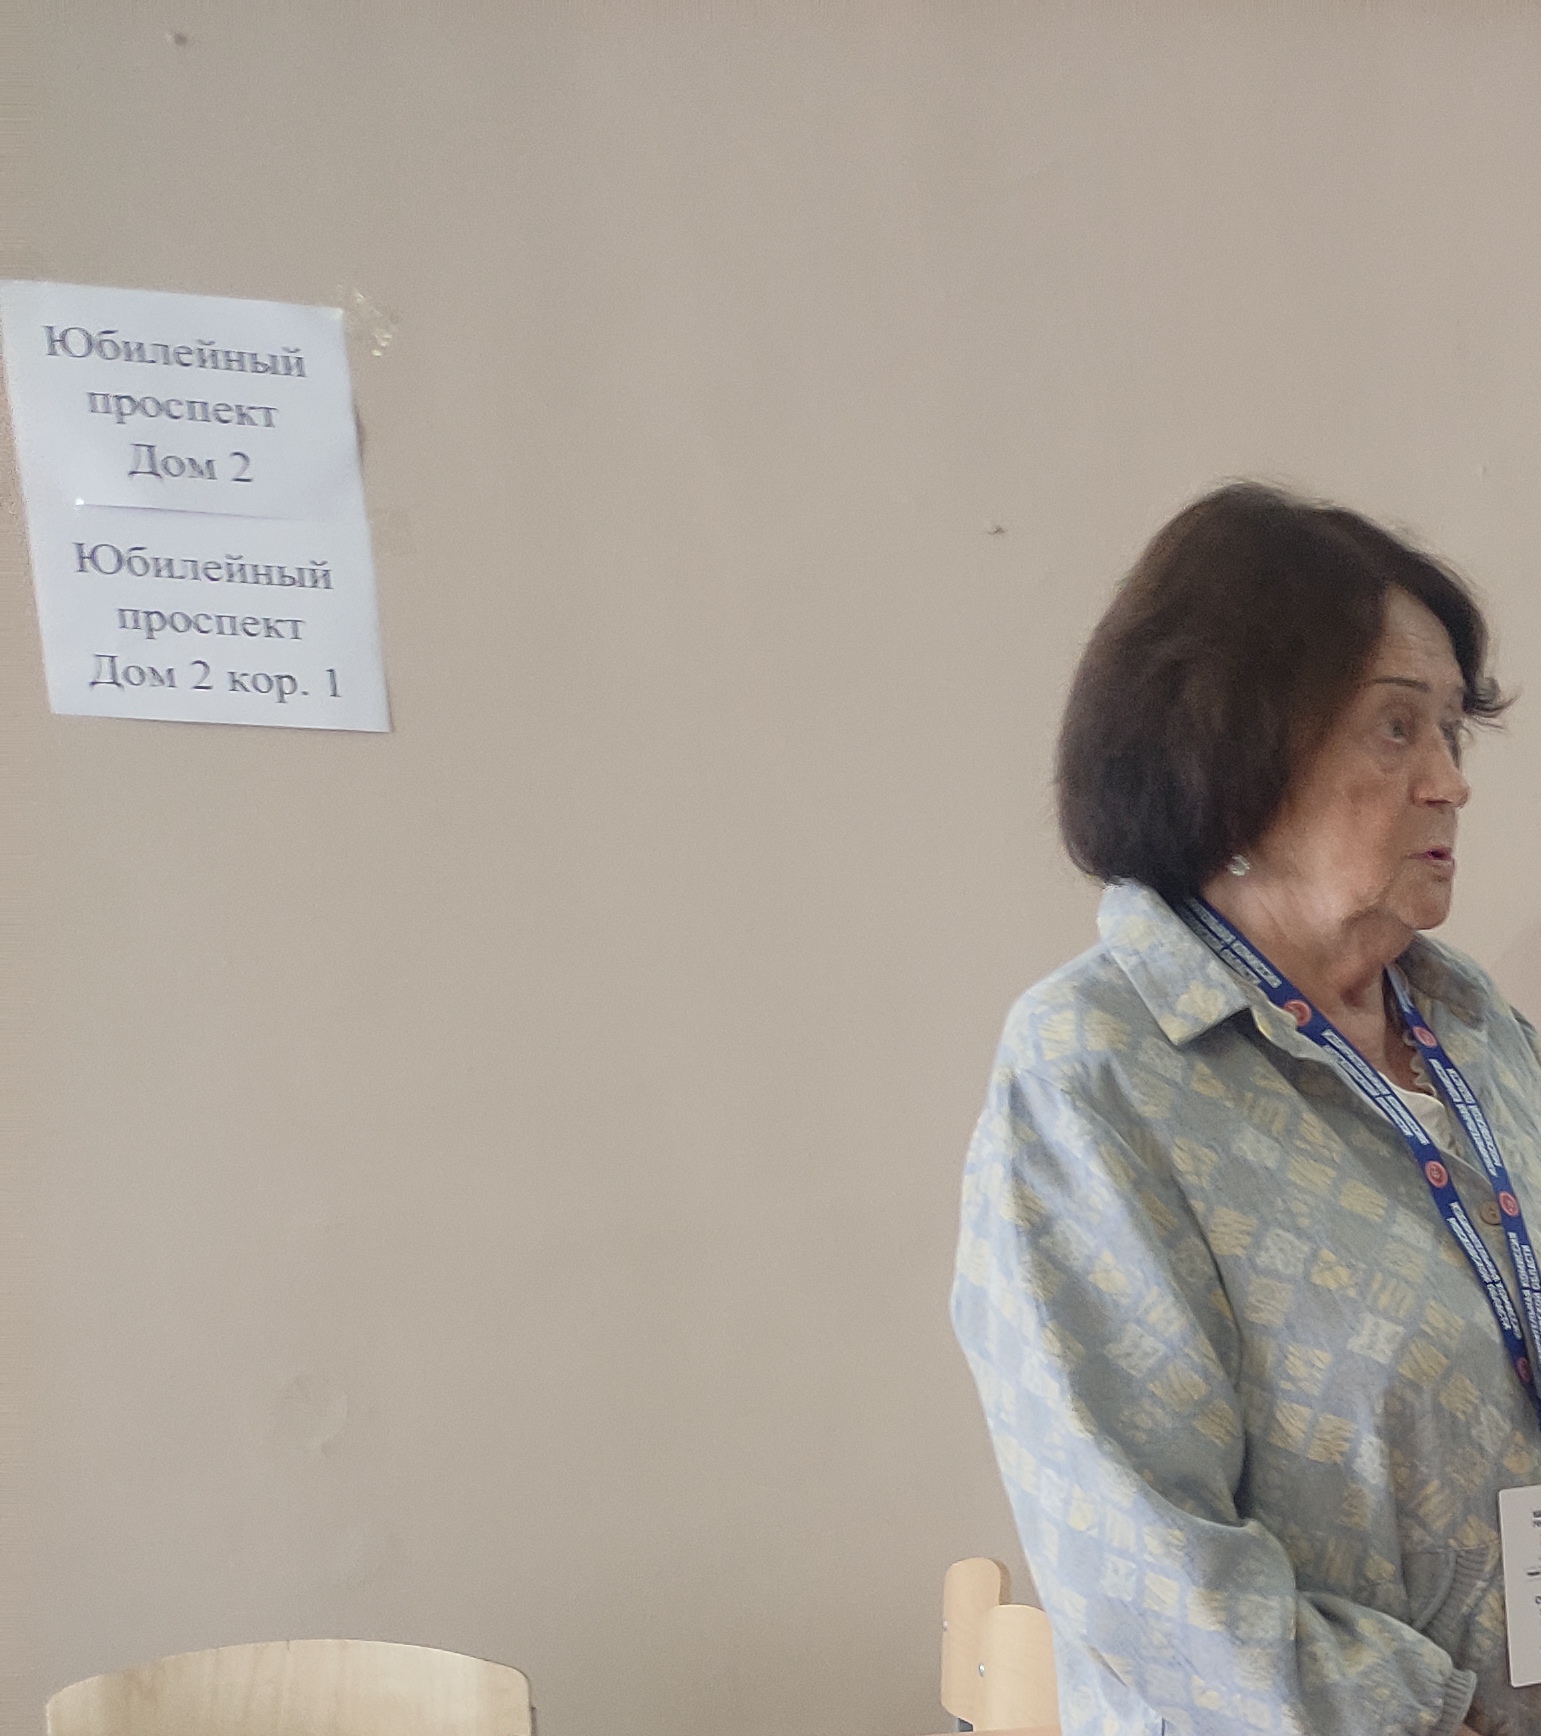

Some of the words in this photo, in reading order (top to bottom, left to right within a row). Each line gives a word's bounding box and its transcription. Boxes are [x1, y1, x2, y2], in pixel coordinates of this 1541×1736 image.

[41, 323, 307, 378] Юбилейный
[87, 390, 279, 428] проспект
[128, 443, 217, 481] Дом
[230, 452, 254, 482] 2
[72, 542, 334, 590] Юбилейный
[117, 606, 305, 640] проспект
[89, 654, 178, 690] Дом
[191, 660, 213, 690] 2
[227, 670, 309, 703] кор.
[326, 668, 342, 698] 1
